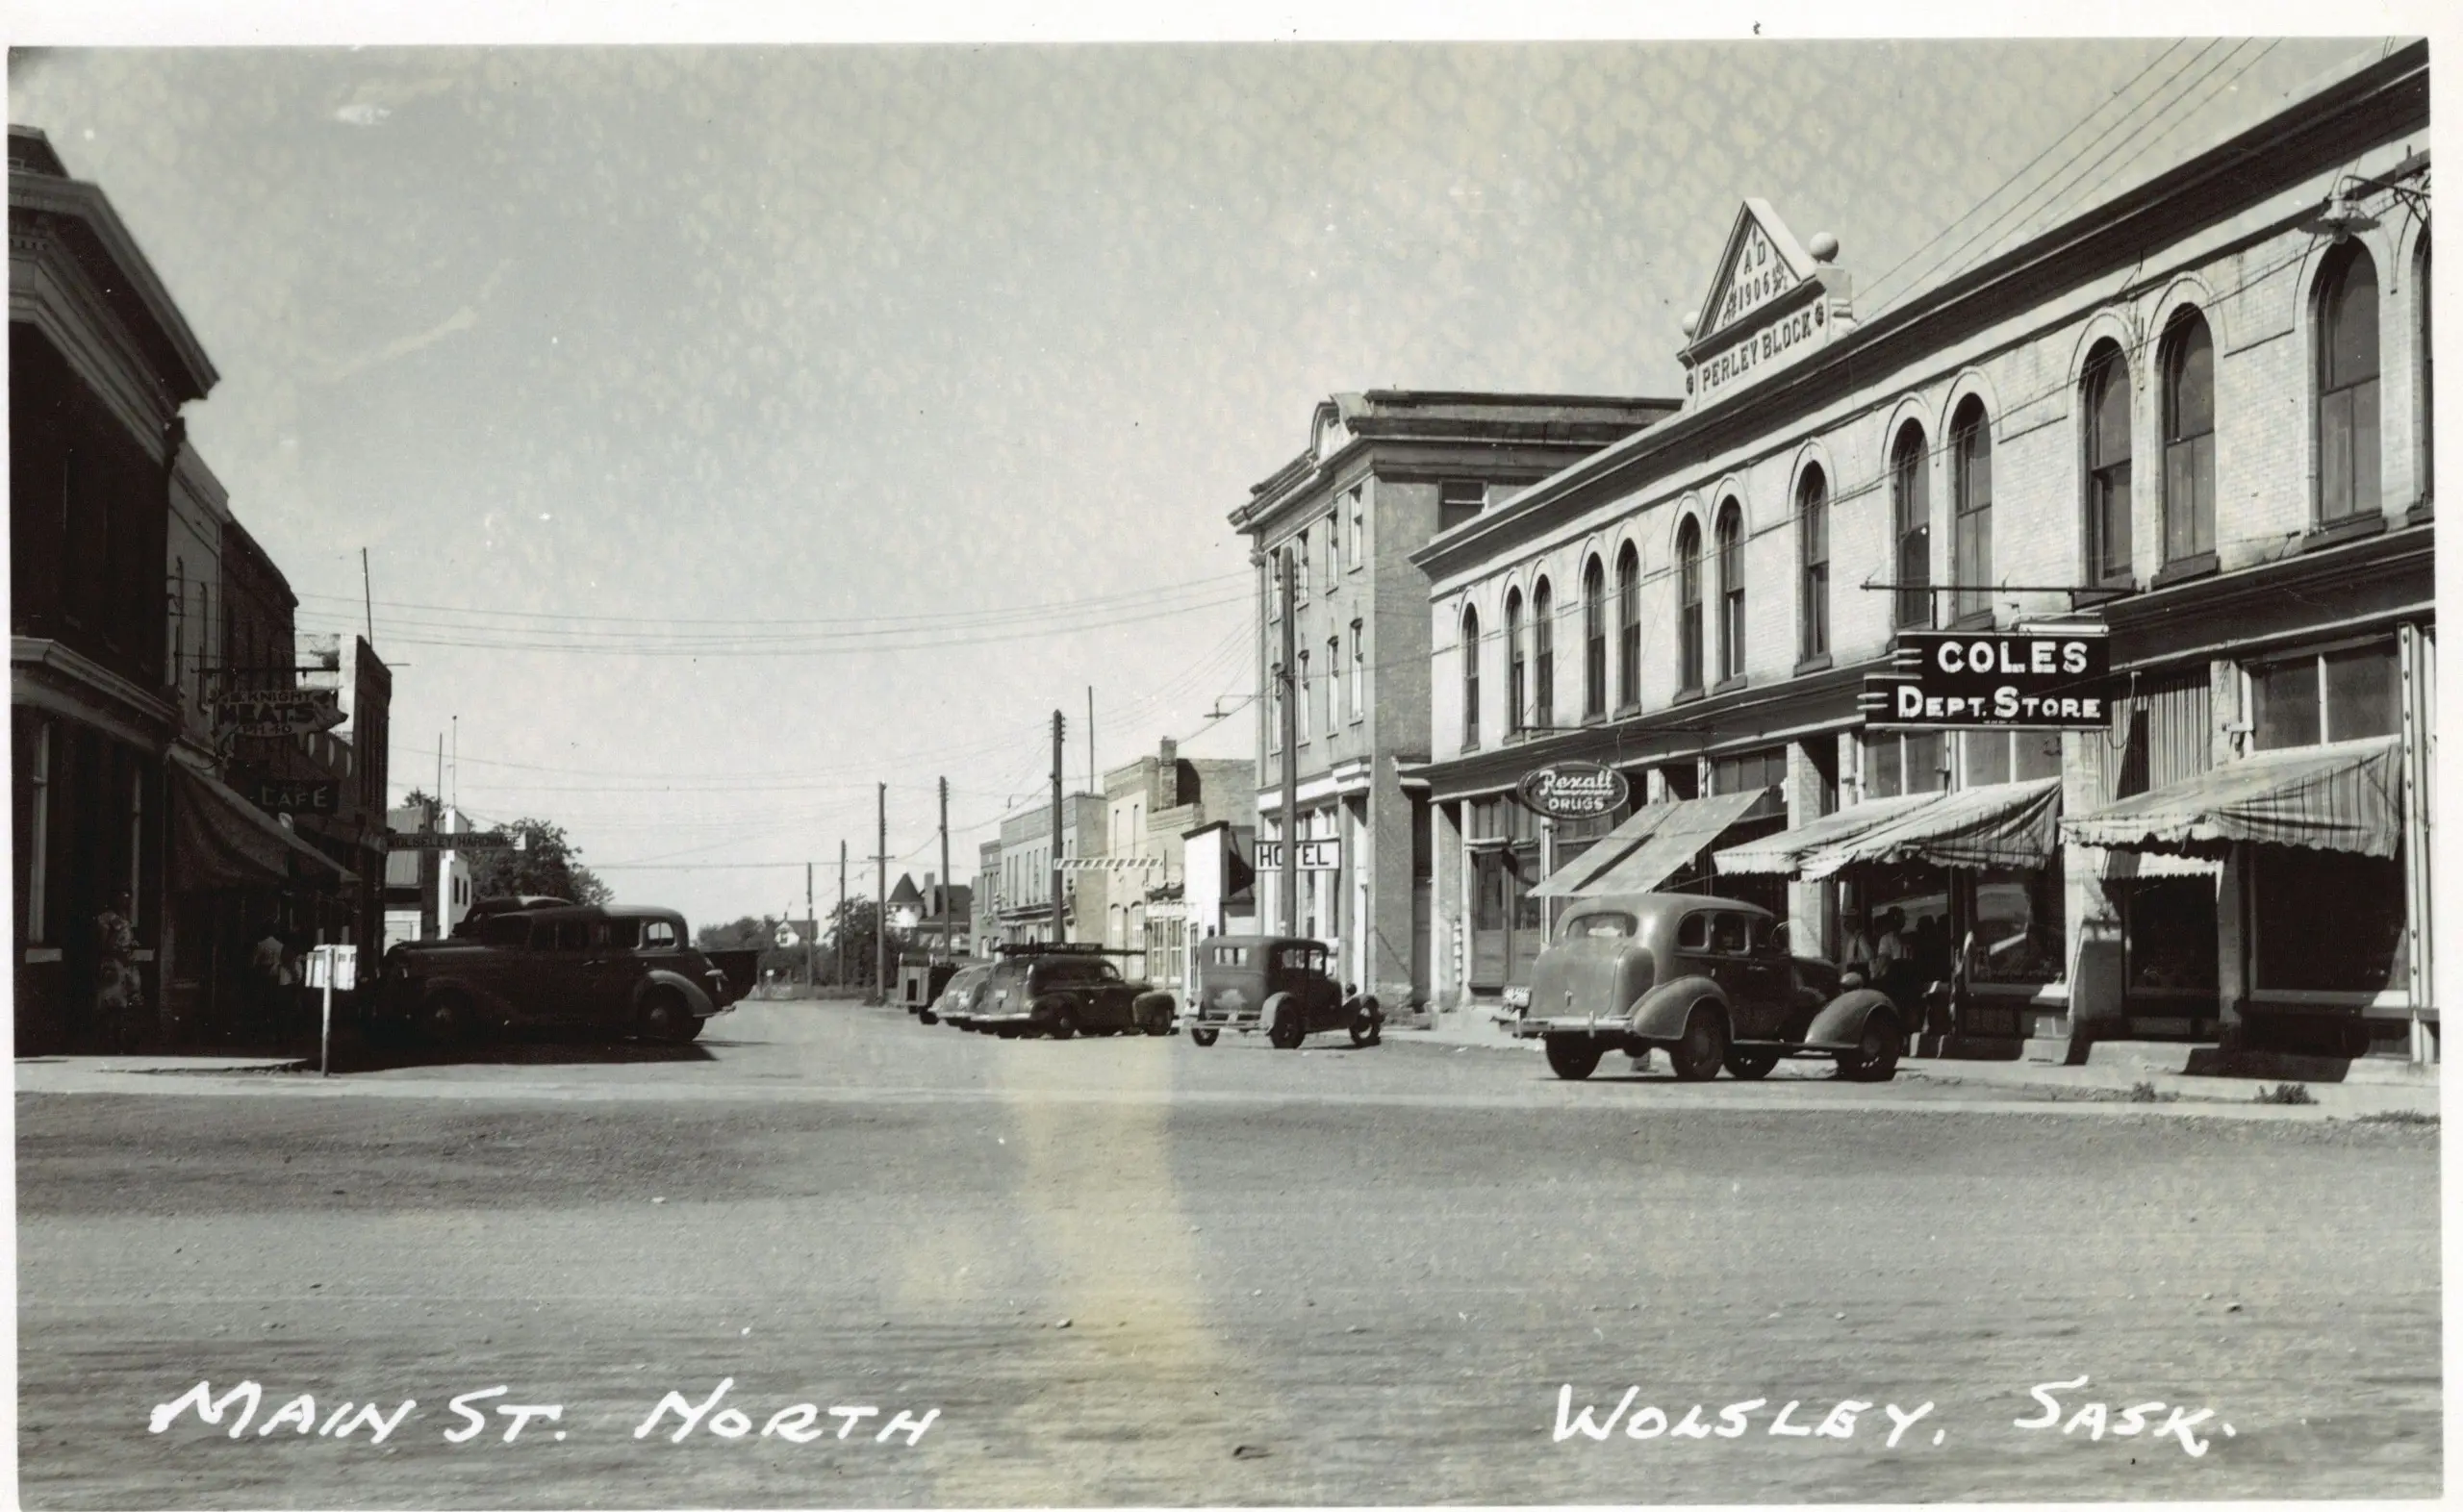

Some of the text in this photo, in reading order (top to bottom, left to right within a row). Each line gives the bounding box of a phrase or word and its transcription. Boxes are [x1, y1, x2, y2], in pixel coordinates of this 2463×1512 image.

[1739, 270, 1770, 312] 1906
[1702, 311, 1812, 391] PERLEY BLOCK
[1938, 641, 2088, 673] COLES
[217, 702, 315, 725] MEATS
[1897, 685, 2102, 718] DEPT. STORE
[1538, 765, 1613, 796] Rexall
[1547, 796, 1605, 811] DRUGS
